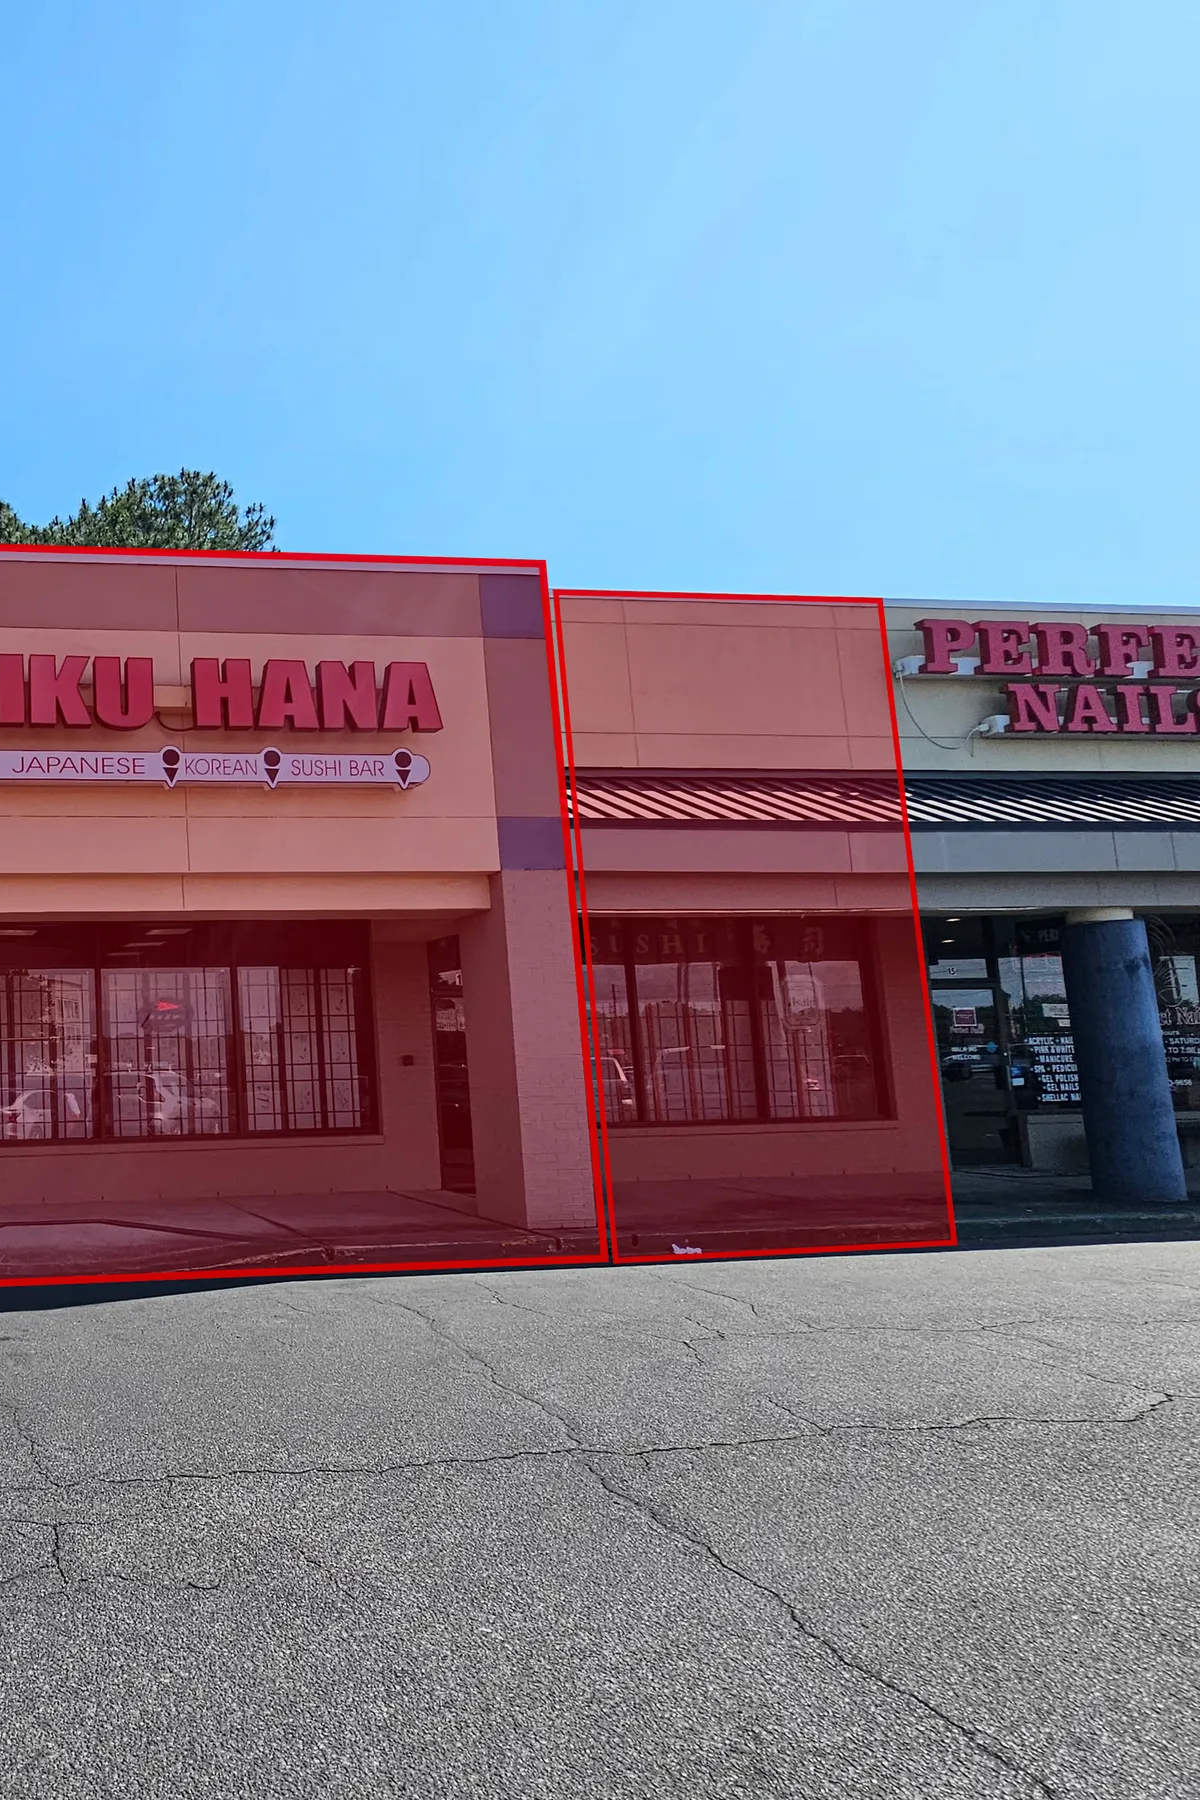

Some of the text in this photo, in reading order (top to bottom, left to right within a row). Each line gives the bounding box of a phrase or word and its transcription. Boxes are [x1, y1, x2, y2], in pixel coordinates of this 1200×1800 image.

[190, 658, 444, 733] HANA
[12, 757, 385, 777] JAPANESE KOREAN SUSHI BAR
[948, 967, 956, 975] 15
[1028, 1036, 1054, 1045] ACRYLIC
[1034, 1045, 1049, 1054] PINK
[1167, 1046, 1179, 1054] TO
[1039, 1054, 1074, 1063] MANICURE
[1034, 1065, 1046, 1073] SPA
[1041, 1074, 1054, 1083] GEL
[1046, 1082, 1080, 1091] GEL NAILS
[1042, 1093, 1068, 1102] SHELLAC
